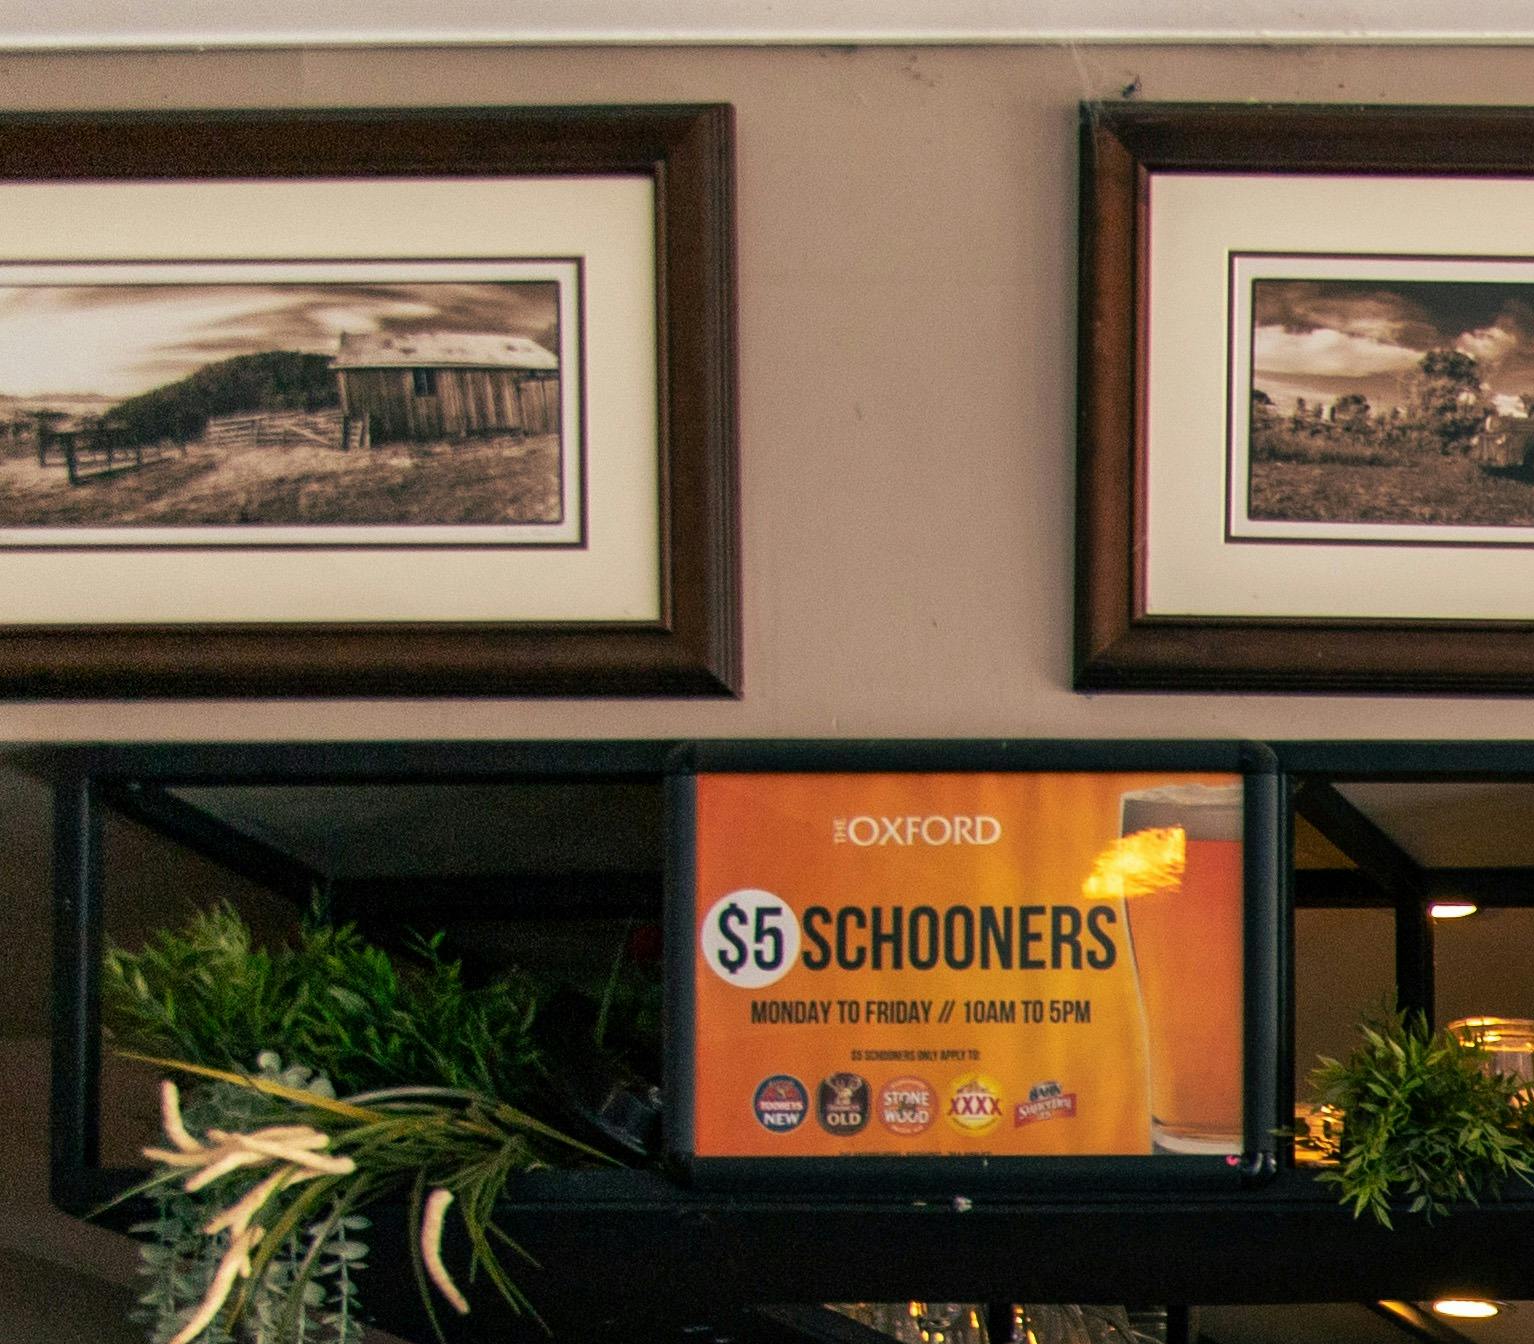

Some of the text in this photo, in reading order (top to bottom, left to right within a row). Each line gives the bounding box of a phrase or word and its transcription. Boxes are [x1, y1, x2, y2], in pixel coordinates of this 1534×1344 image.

[847, 815, 1002, 847] OXFORD
[716, 902, 1117, 975] $5 SCHOONERS
[751, 1000, 831, 1025] MONDAY
[837, 1000, 860, 1025] TO
[865, 1000, 931, 1025] FRIDAY
[963, 1000, 1016, 1025] 10AM
[1021, 1000, 1045, 1025] TO
[1049, 1000, 1092, 1025] 5PM
[946, 1094, 1003, 1117] XXXX
[763, 1112, 800, 1126] NEW
[827, 1112, 862, 1126] OLD
